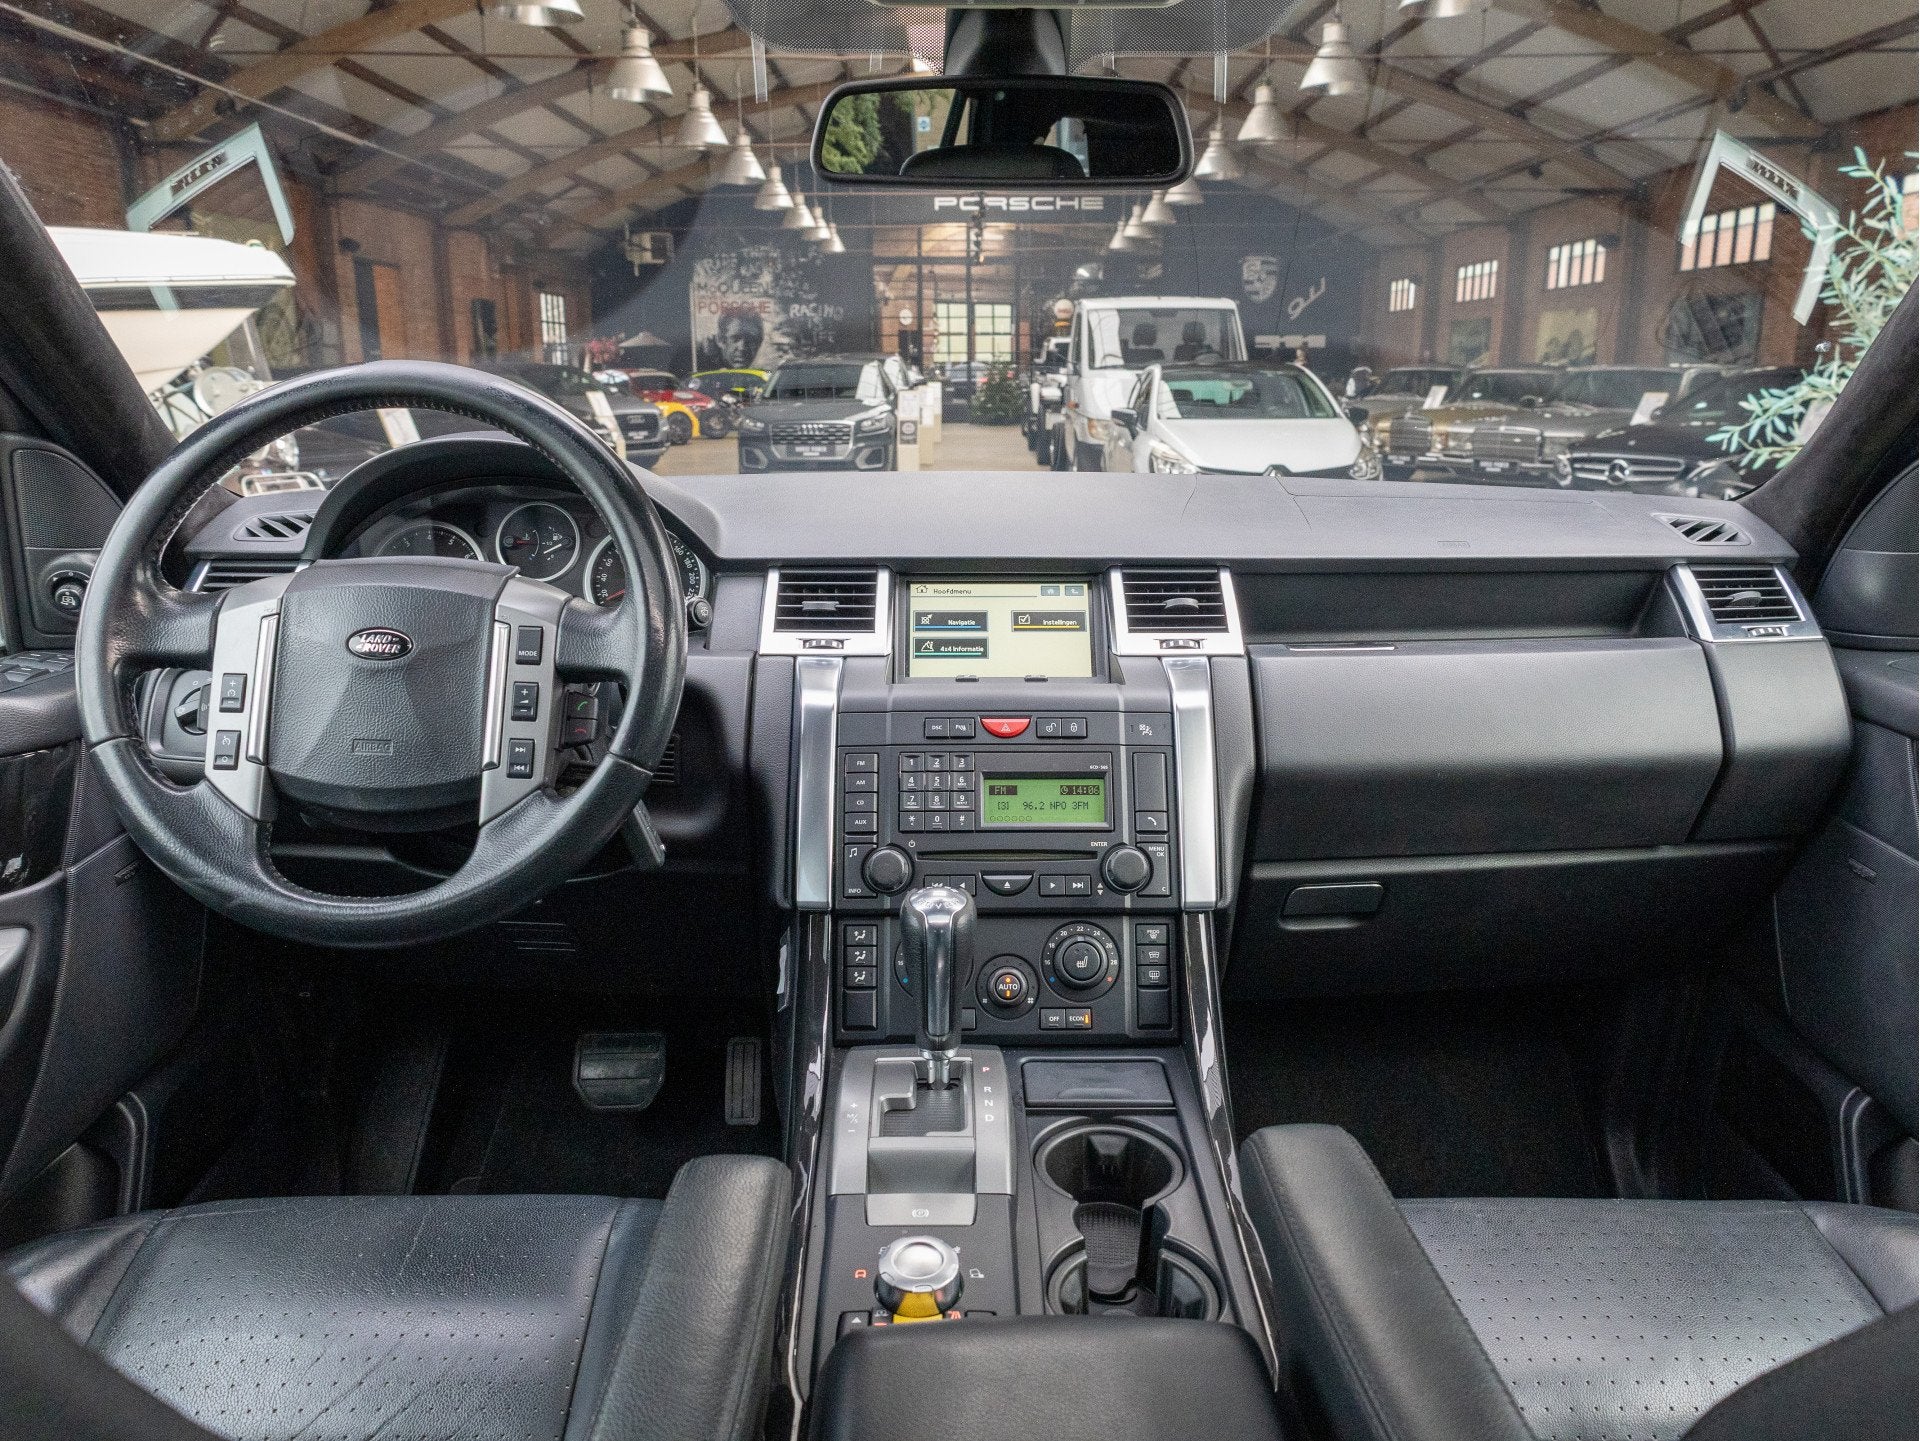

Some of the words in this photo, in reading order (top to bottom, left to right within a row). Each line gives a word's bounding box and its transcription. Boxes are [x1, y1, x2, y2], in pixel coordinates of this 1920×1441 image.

[933, 196, 1104, 211] PORSCHE
[360, 634, 392, 643] LAND
[362, 643, 400, 653] ROVER
[994, 786, 1007, 795] FM
[1072, 785, 1100, 795] 14:06
[959, 794, 965, 802] 9
[1022, 801, 1045, 810] 96.2
[1050, 801, 1067, 810] NPO
[1072, 801, 1089, 810] 3FM
[934, 815, 940, 823] 0
[985, 1114, 995, 1122] D
